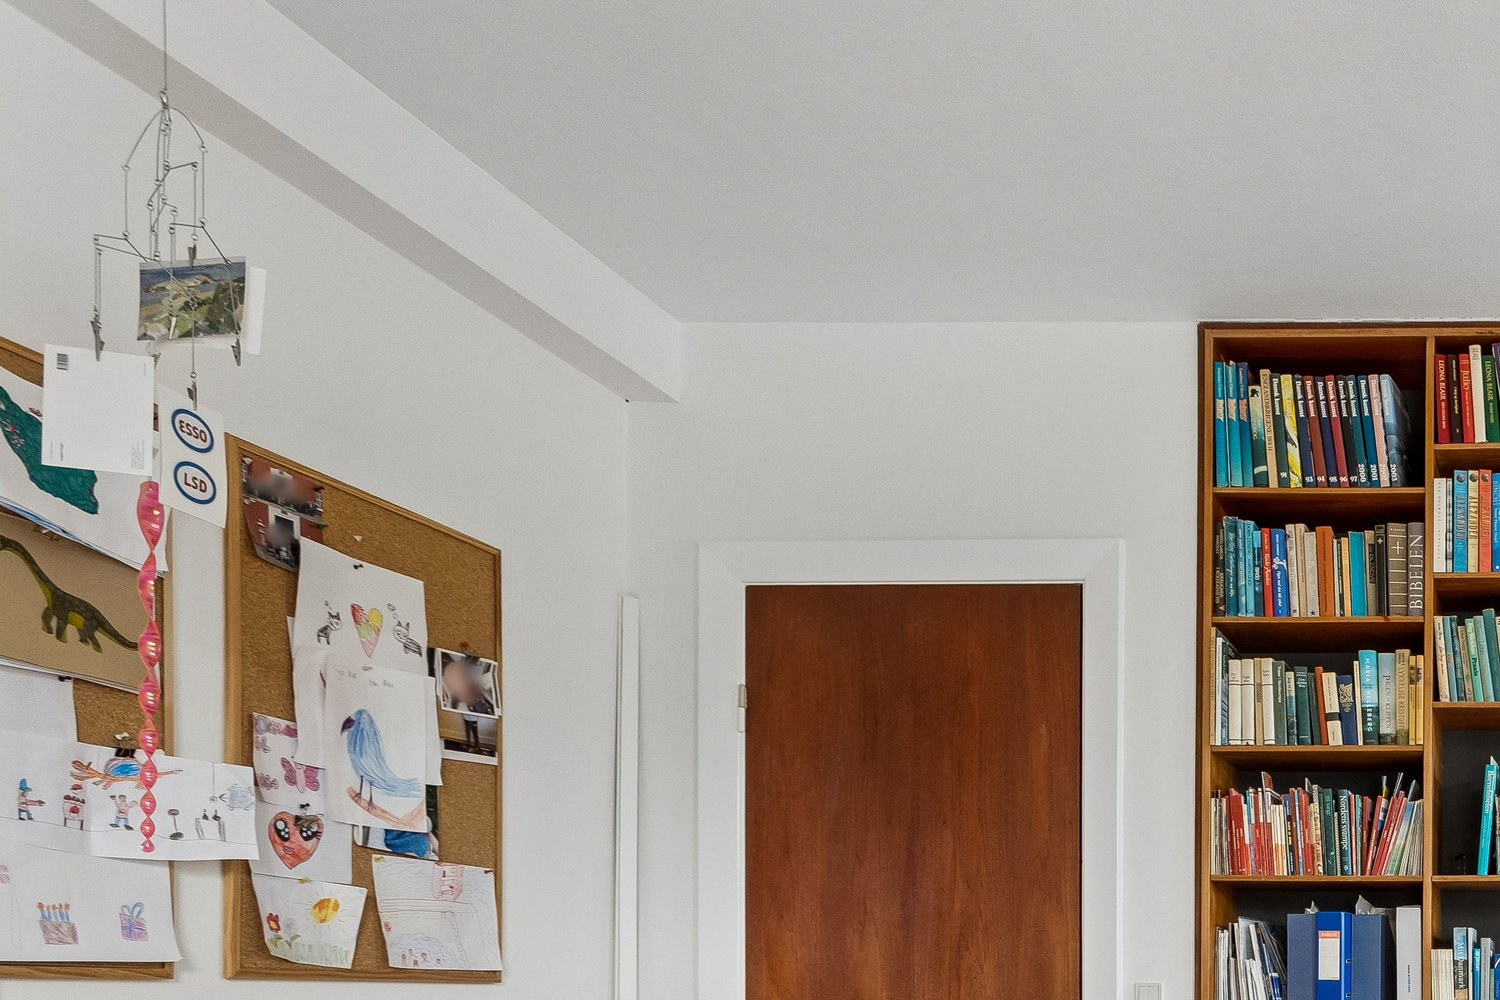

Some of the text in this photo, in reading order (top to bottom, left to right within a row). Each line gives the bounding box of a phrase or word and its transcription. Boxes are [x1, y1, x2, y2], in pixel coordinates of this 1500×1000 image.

[1461, 370, 1470, 390] Julio
[179, 420, 207, 442] ESSO
[184, 472, 207, 494] LSD
[1357, 463, 1365, 482] 2000
[1370, 464, 1378, 481] 2001
[1455, 496, 1466, 540] ALEXANDER
[1469, 496, 1478, 540] ALEXANDER
[1481, 496, 1490, 540] ALEXANDER
[1409, 534, 1423, 610] BIBELEN
[1484, 770, 1495, 814] Børnebibelen
[1340, 795, 1350, 850] Nordens svampe
[1458, 958, 1467, 989] Danmark
